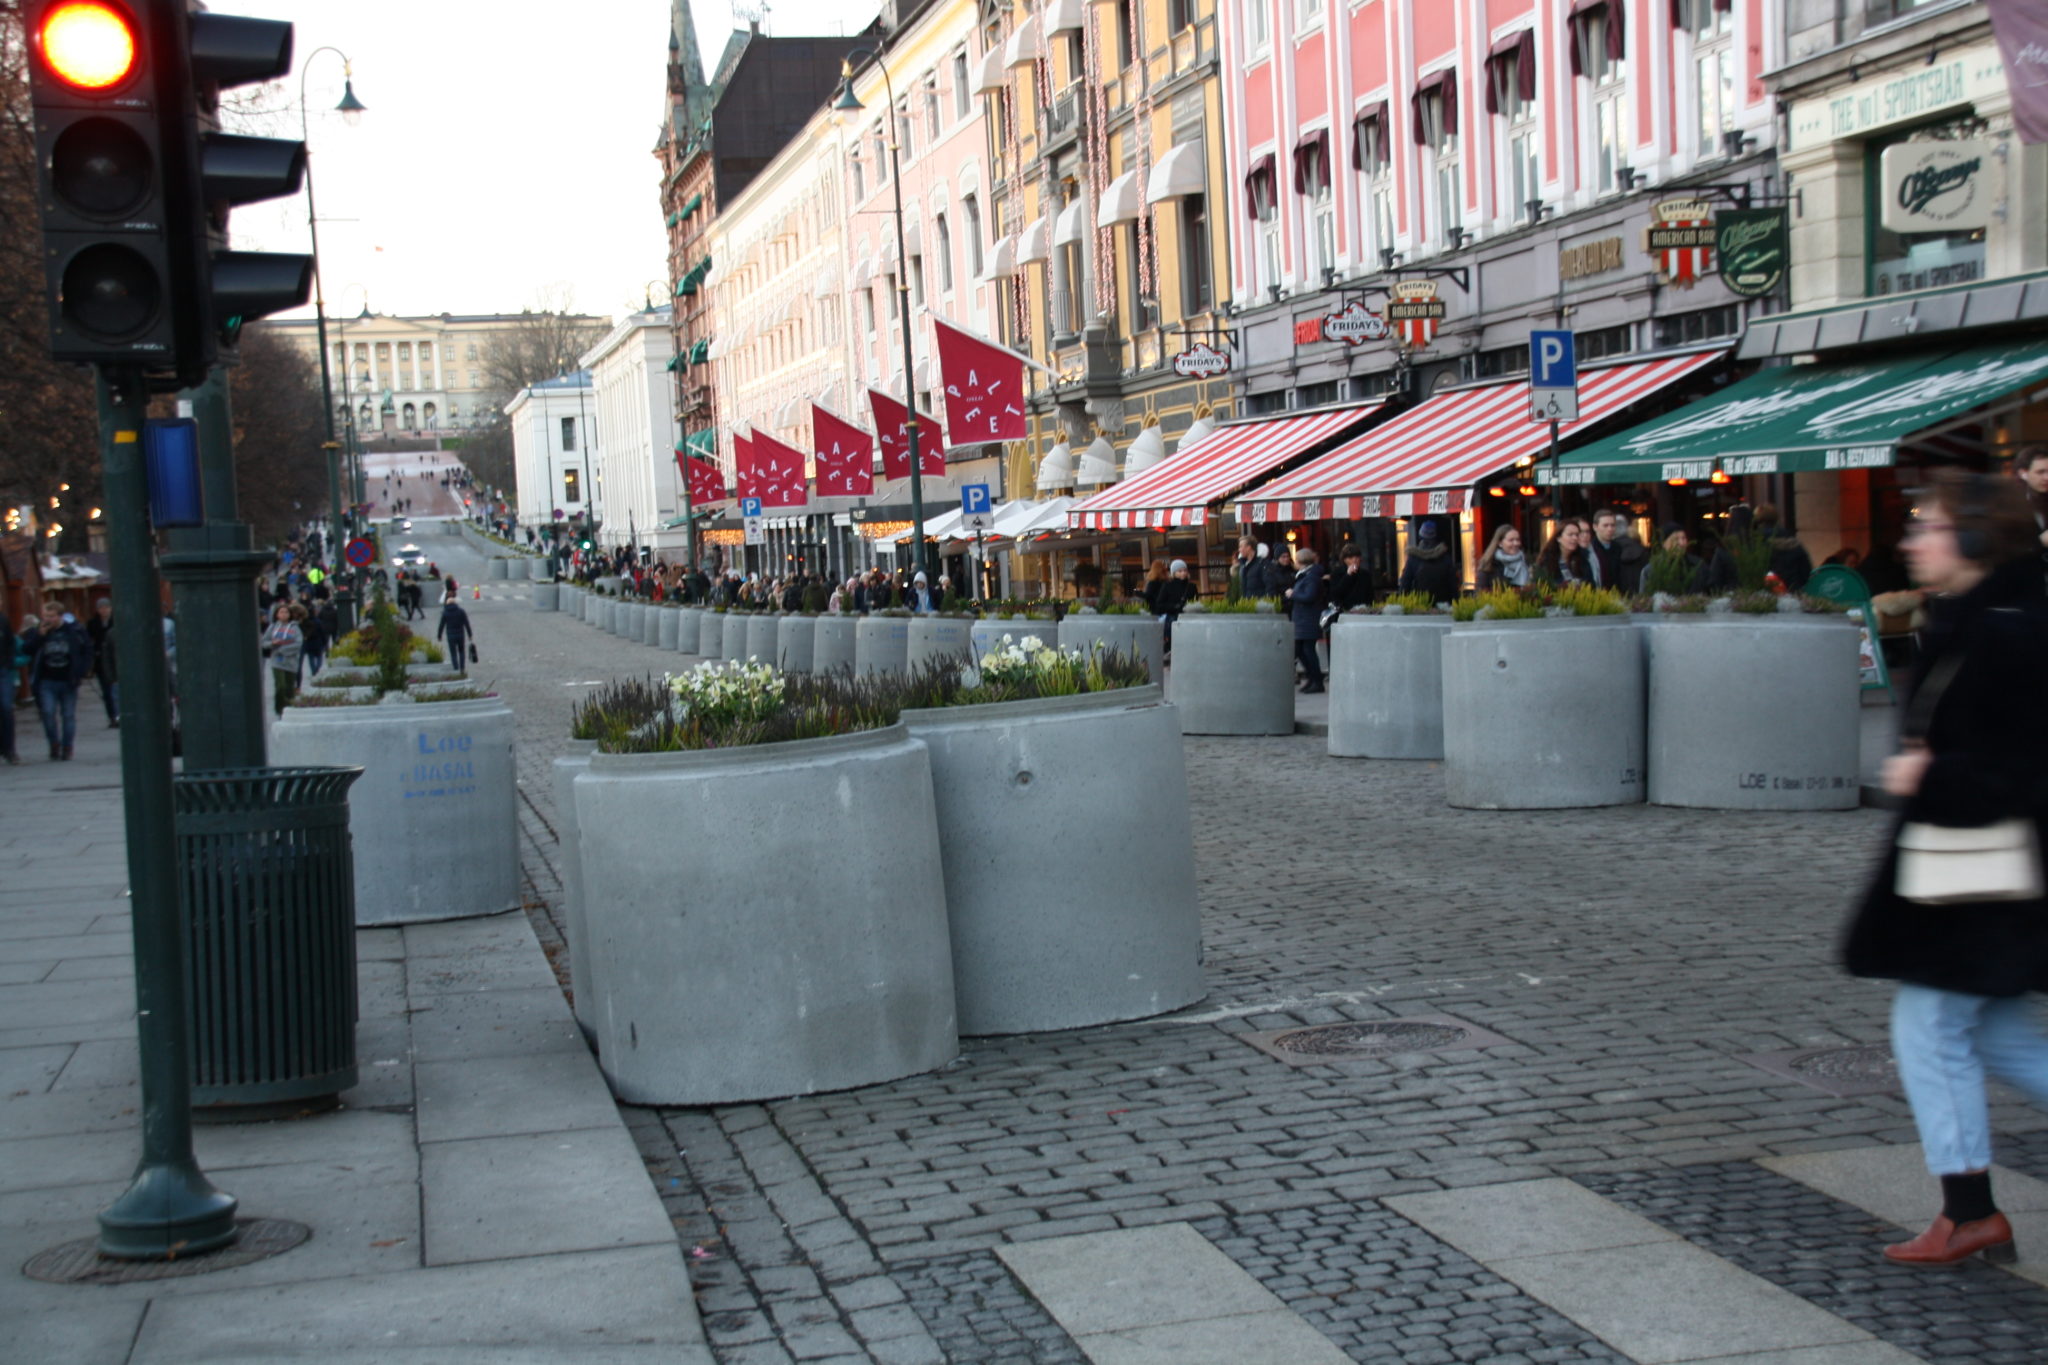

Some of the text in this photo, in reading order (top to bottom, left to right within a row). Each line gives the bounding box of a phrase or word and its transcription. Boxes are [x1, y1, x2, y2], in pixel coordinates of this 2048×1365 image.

[1830, 96, 1855, 136] THE
[1883, 61, 1964, 121] SPORTSBAR
[1652, 230, 1697, 247] AMERICAN
[1399, 282, 1434, 292] FRIDAY'S
[1392, 305, 1442, 318] AMERICAN BAR
[1333, 320, 1380, 331] FRIDAY'S
[1182, 358, 1222, 367] FRIDAY'S
[1541, 337, 1563, 381] P
[969, 488, 984, 511] P
[746, 500, 756, 516] P
